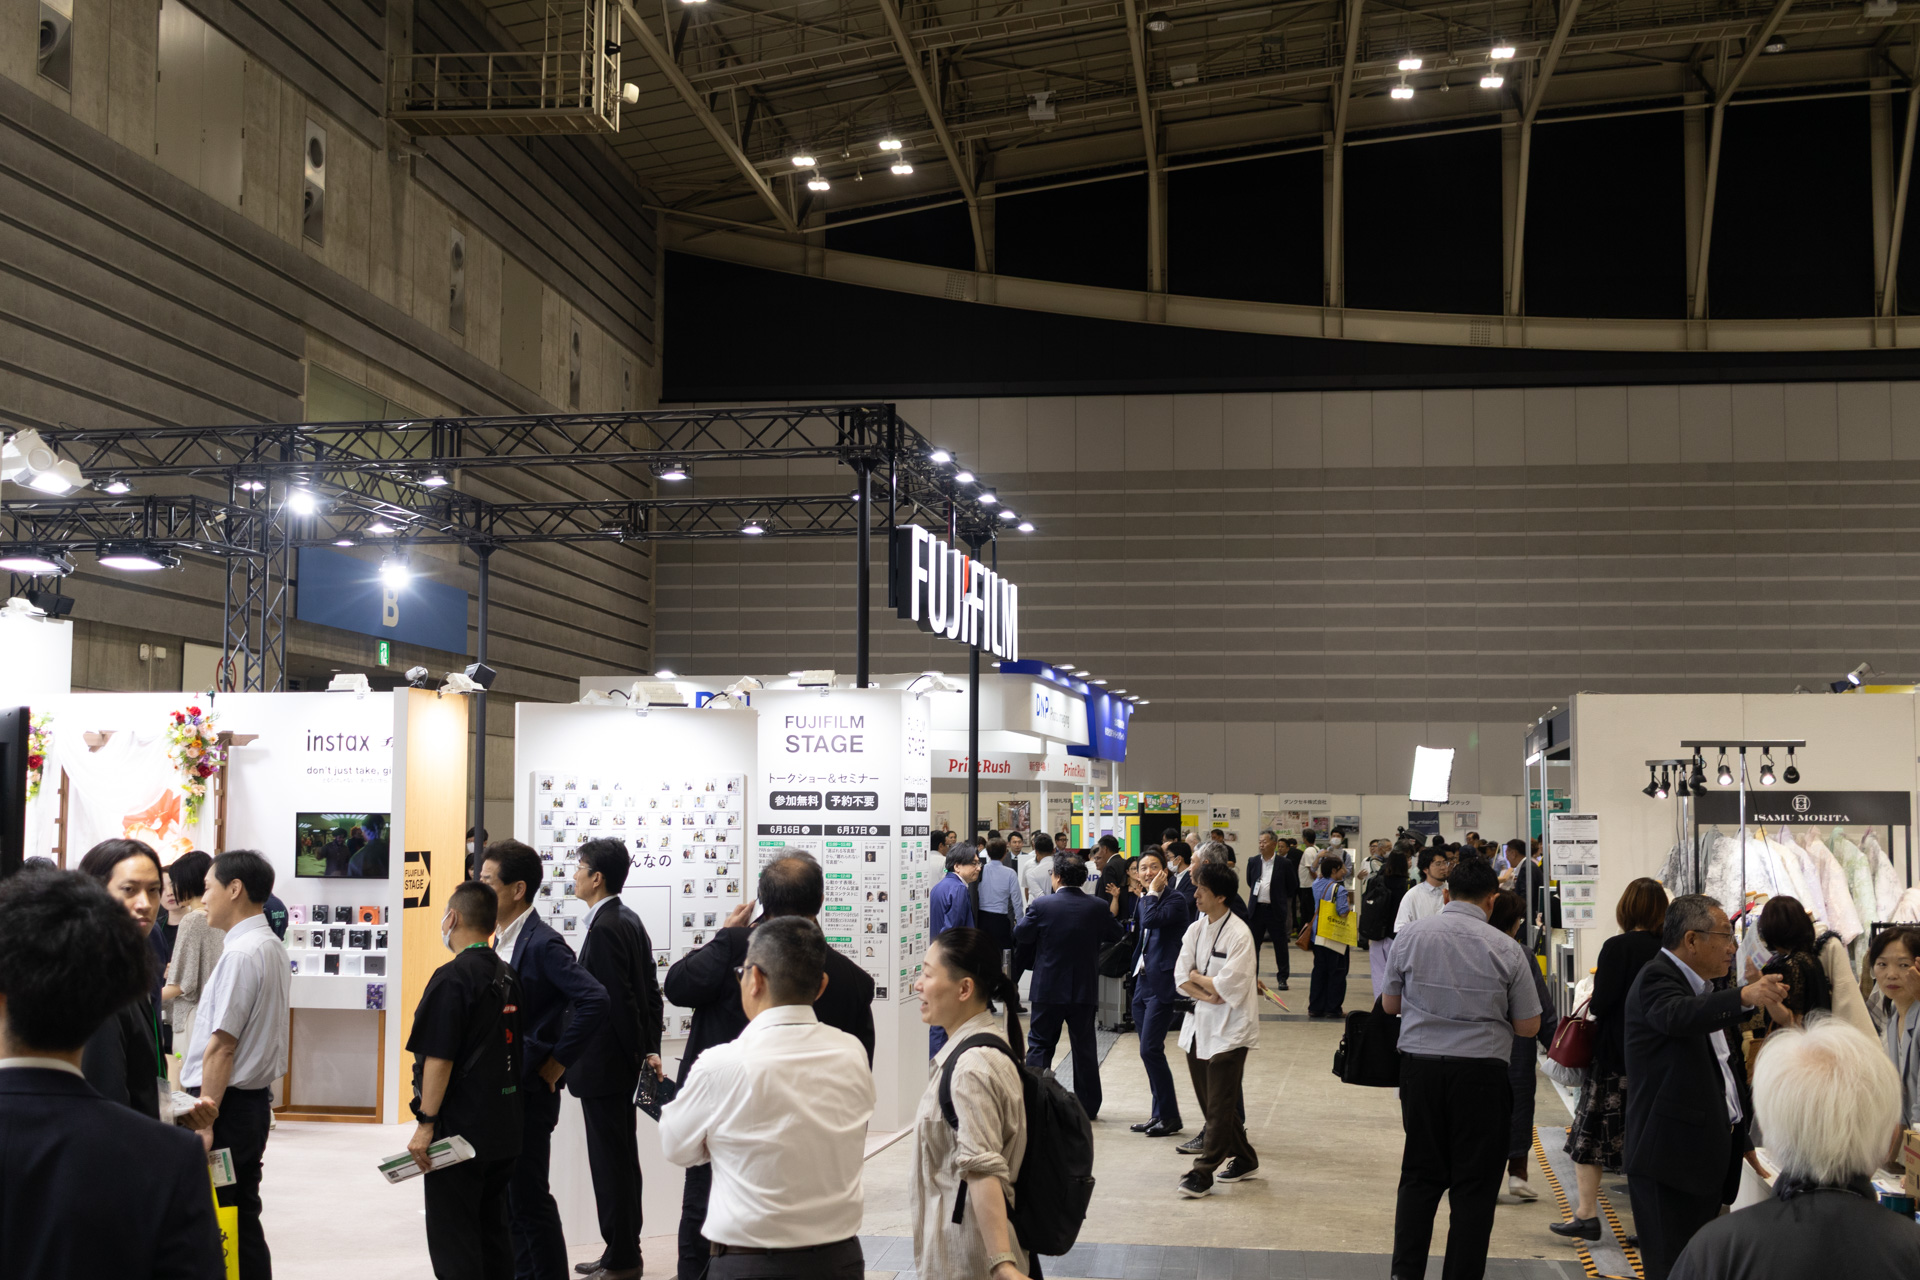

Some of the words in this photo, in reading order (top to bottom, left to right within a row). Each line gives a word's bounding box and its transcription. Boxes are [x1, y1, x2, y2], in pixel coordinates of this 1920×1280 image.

[911, 523, 1018, 663] FUJIFILM
[383, 582, 400, 628] B
[1036, 693, 1050, 719] DNP
[785, 715, 864, 729] FUJIFILM
[306, 729, 370, 752] instax
[785, 734, 864, 753] STAGE
[306, 766, 331, 775] don't
[334, 767, 352, 776] just
[774, 795, 819, 807] 参加無料
[830, 795, 875, 807] 予約不要
[1753, 814, 1795, 823] ISAMU
[1797, 814, 1851, 823] MORITA
[405, 869, 425, 877] FUJIFILM
[405, 879, 424, 890] STAGE
